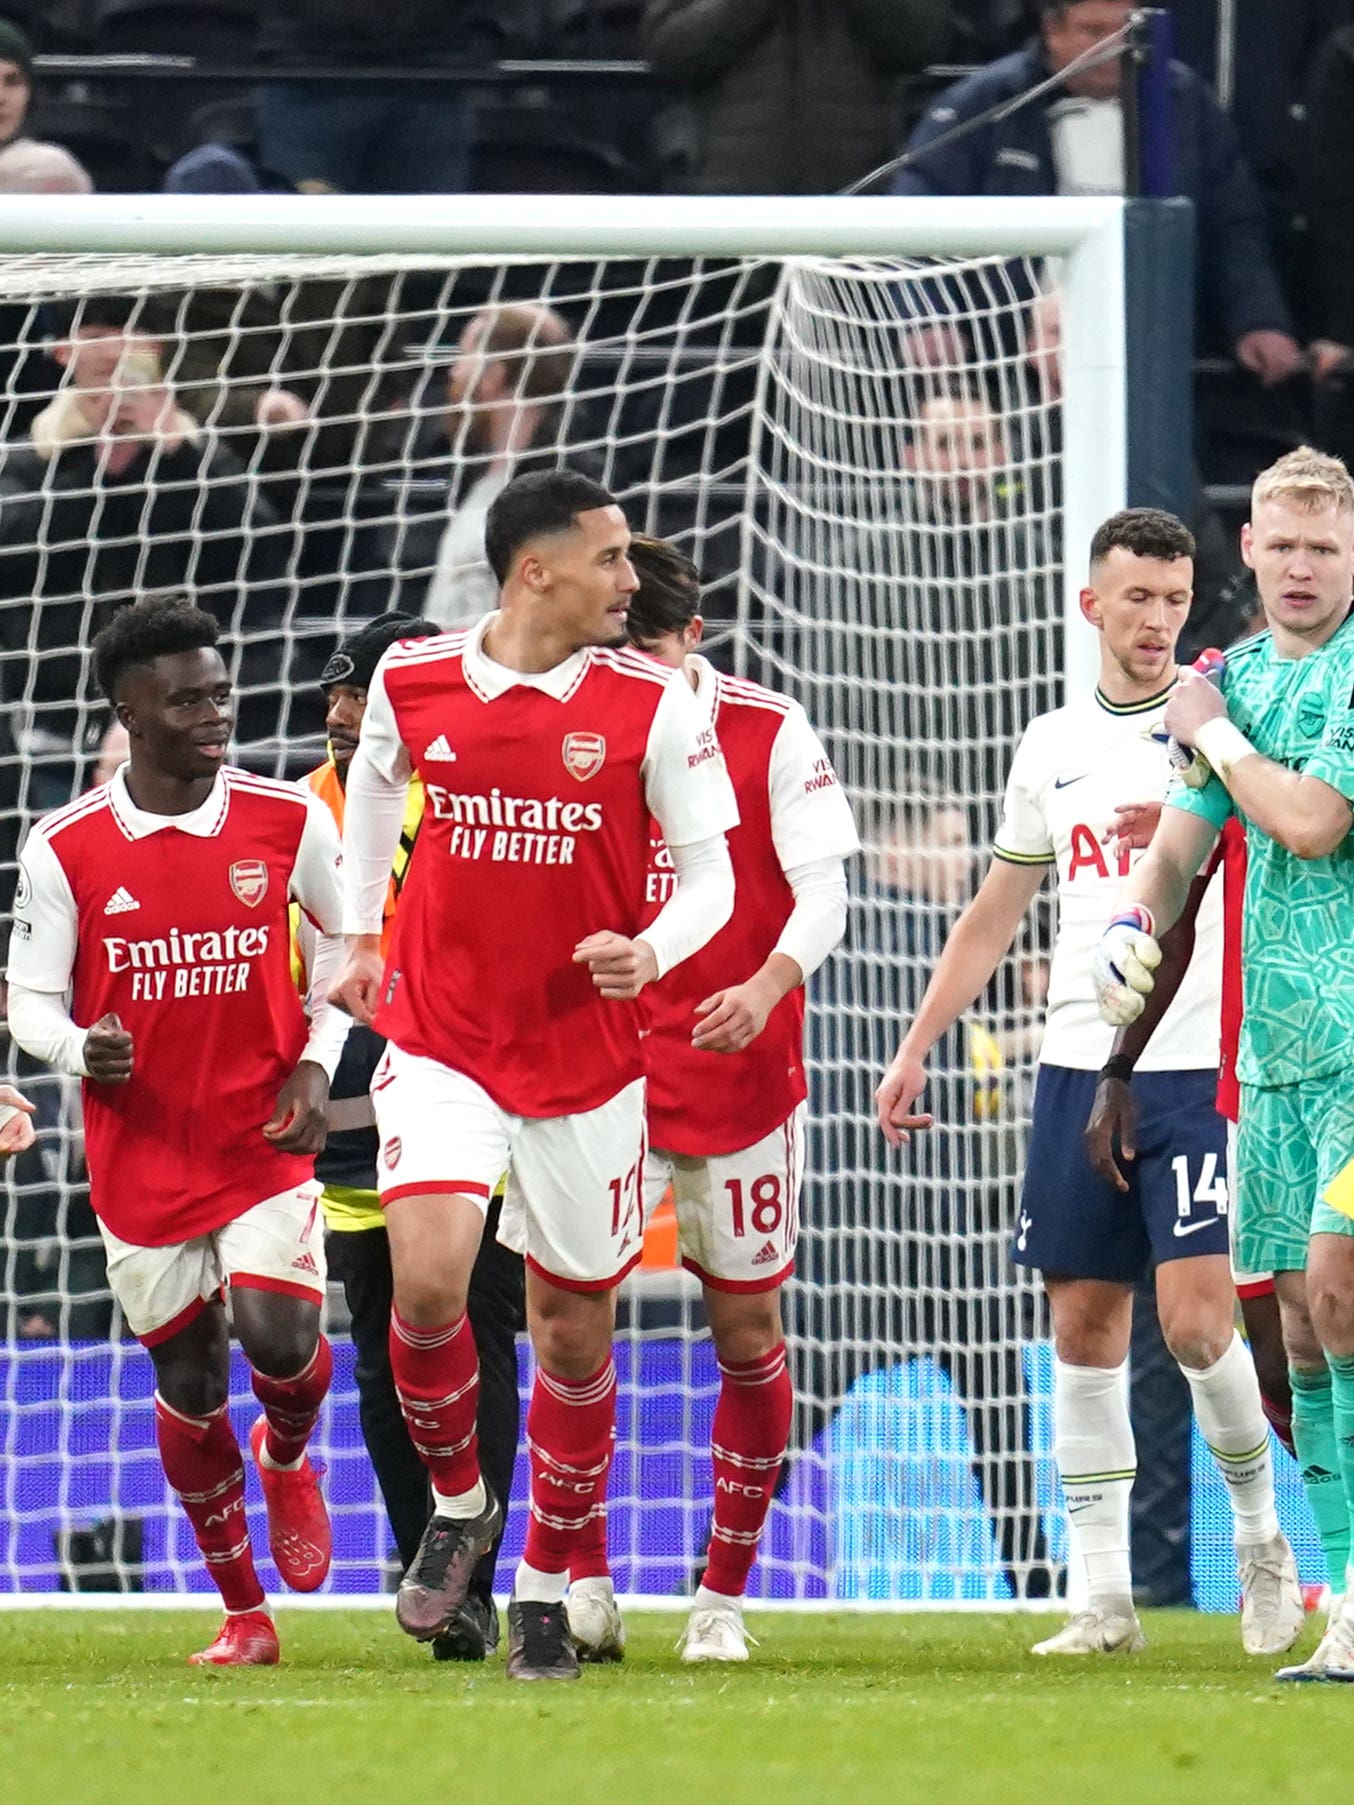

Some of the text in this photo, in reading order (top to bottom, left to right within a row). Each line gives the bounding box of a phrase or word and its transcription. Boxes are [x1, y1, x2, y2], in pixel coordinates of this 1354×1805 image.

[426, 783, 603, 832] Emirates
[450, 826, 576, 865] FLY BETTER
[102, 925, 269, 973] Emirates
[131, 962, 250, 1001] FLY BETTER
[724, 1174, 782, 1237] 18
[1171, 1152, 1229, 1216] 14
[717, 1477, 763, 1498] AFC
